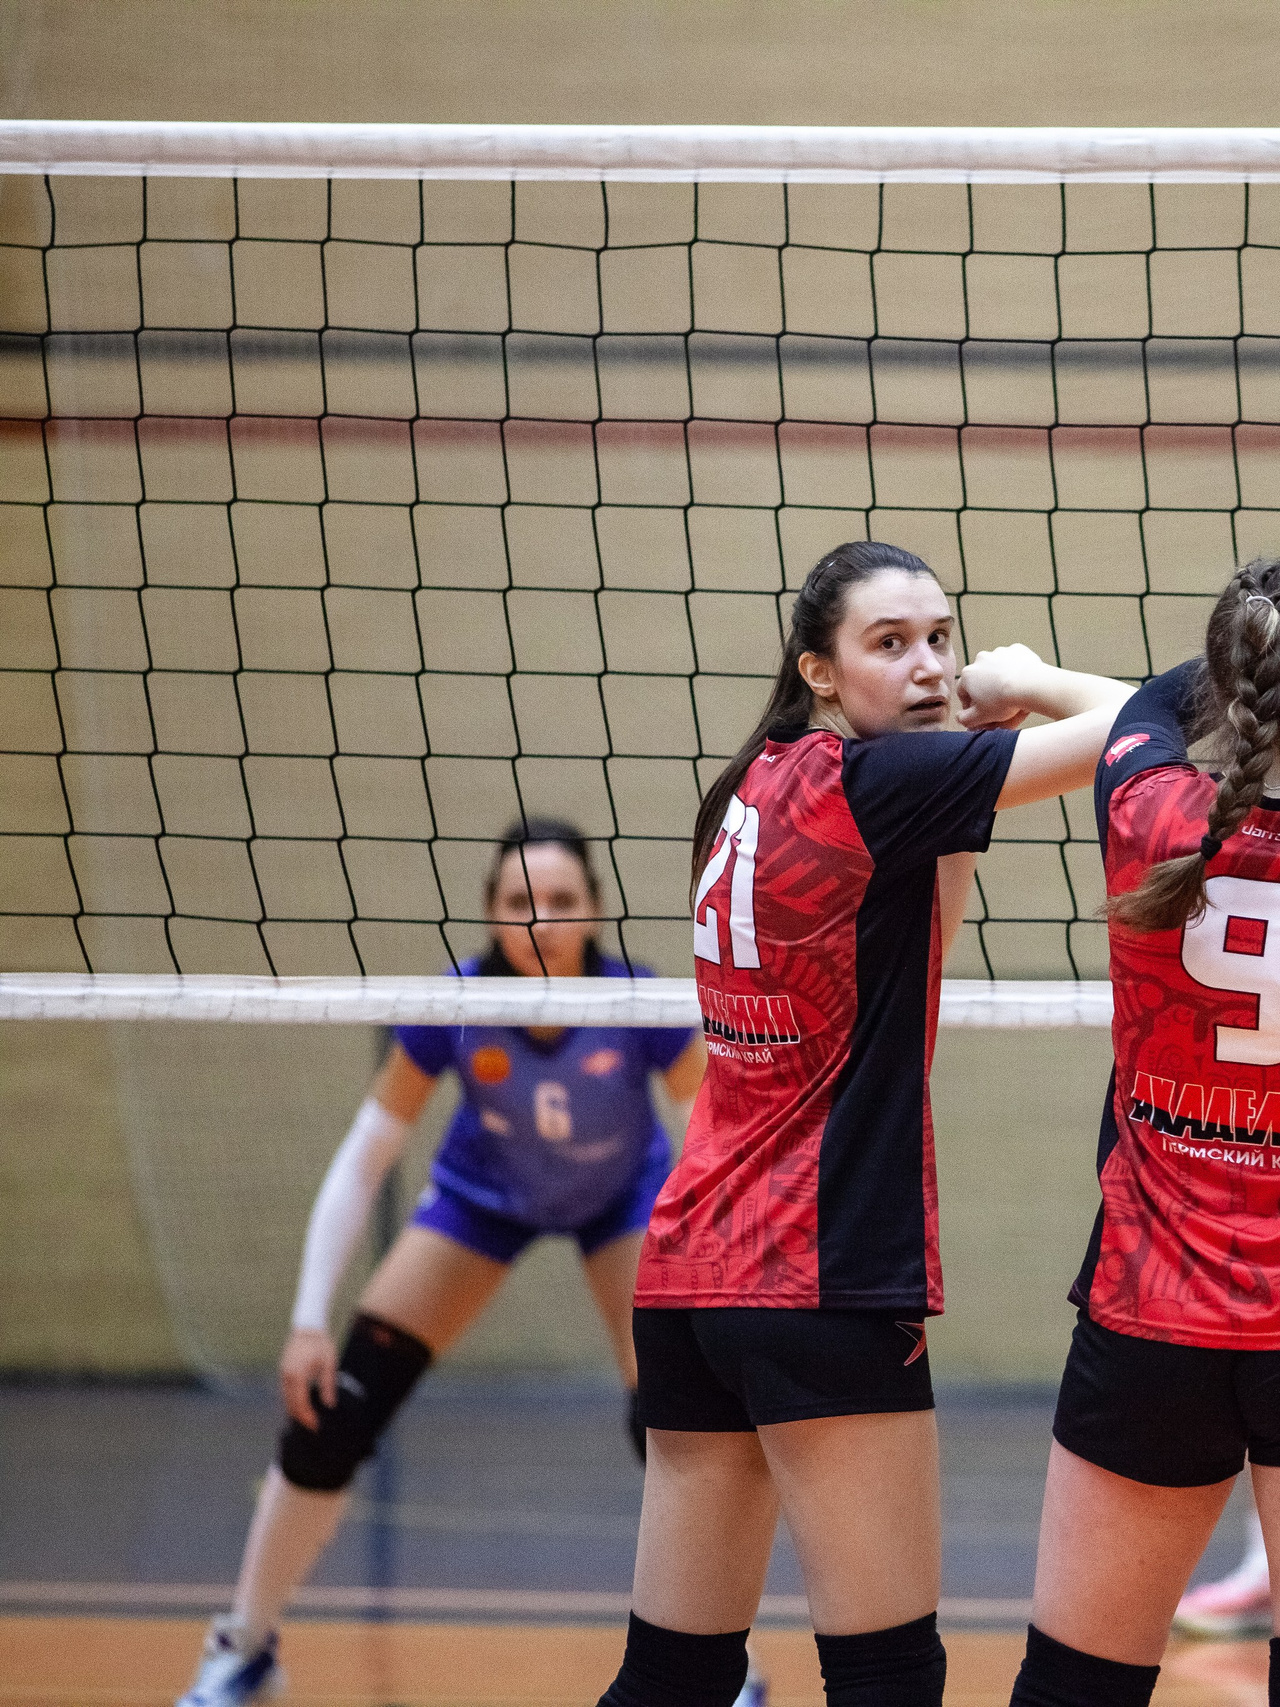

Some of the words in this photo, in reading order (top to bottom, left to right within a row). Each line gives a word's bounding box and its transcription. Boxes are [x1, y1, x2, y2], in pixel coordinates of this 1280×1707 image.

[694, 793, 762, 969] 21
[742, 1048, 775, 1064] КРАЙ
[534, 1080, 572, 1142] 6
[1161, 1136, 1265, 1168] ПЕРМСКИЙ
